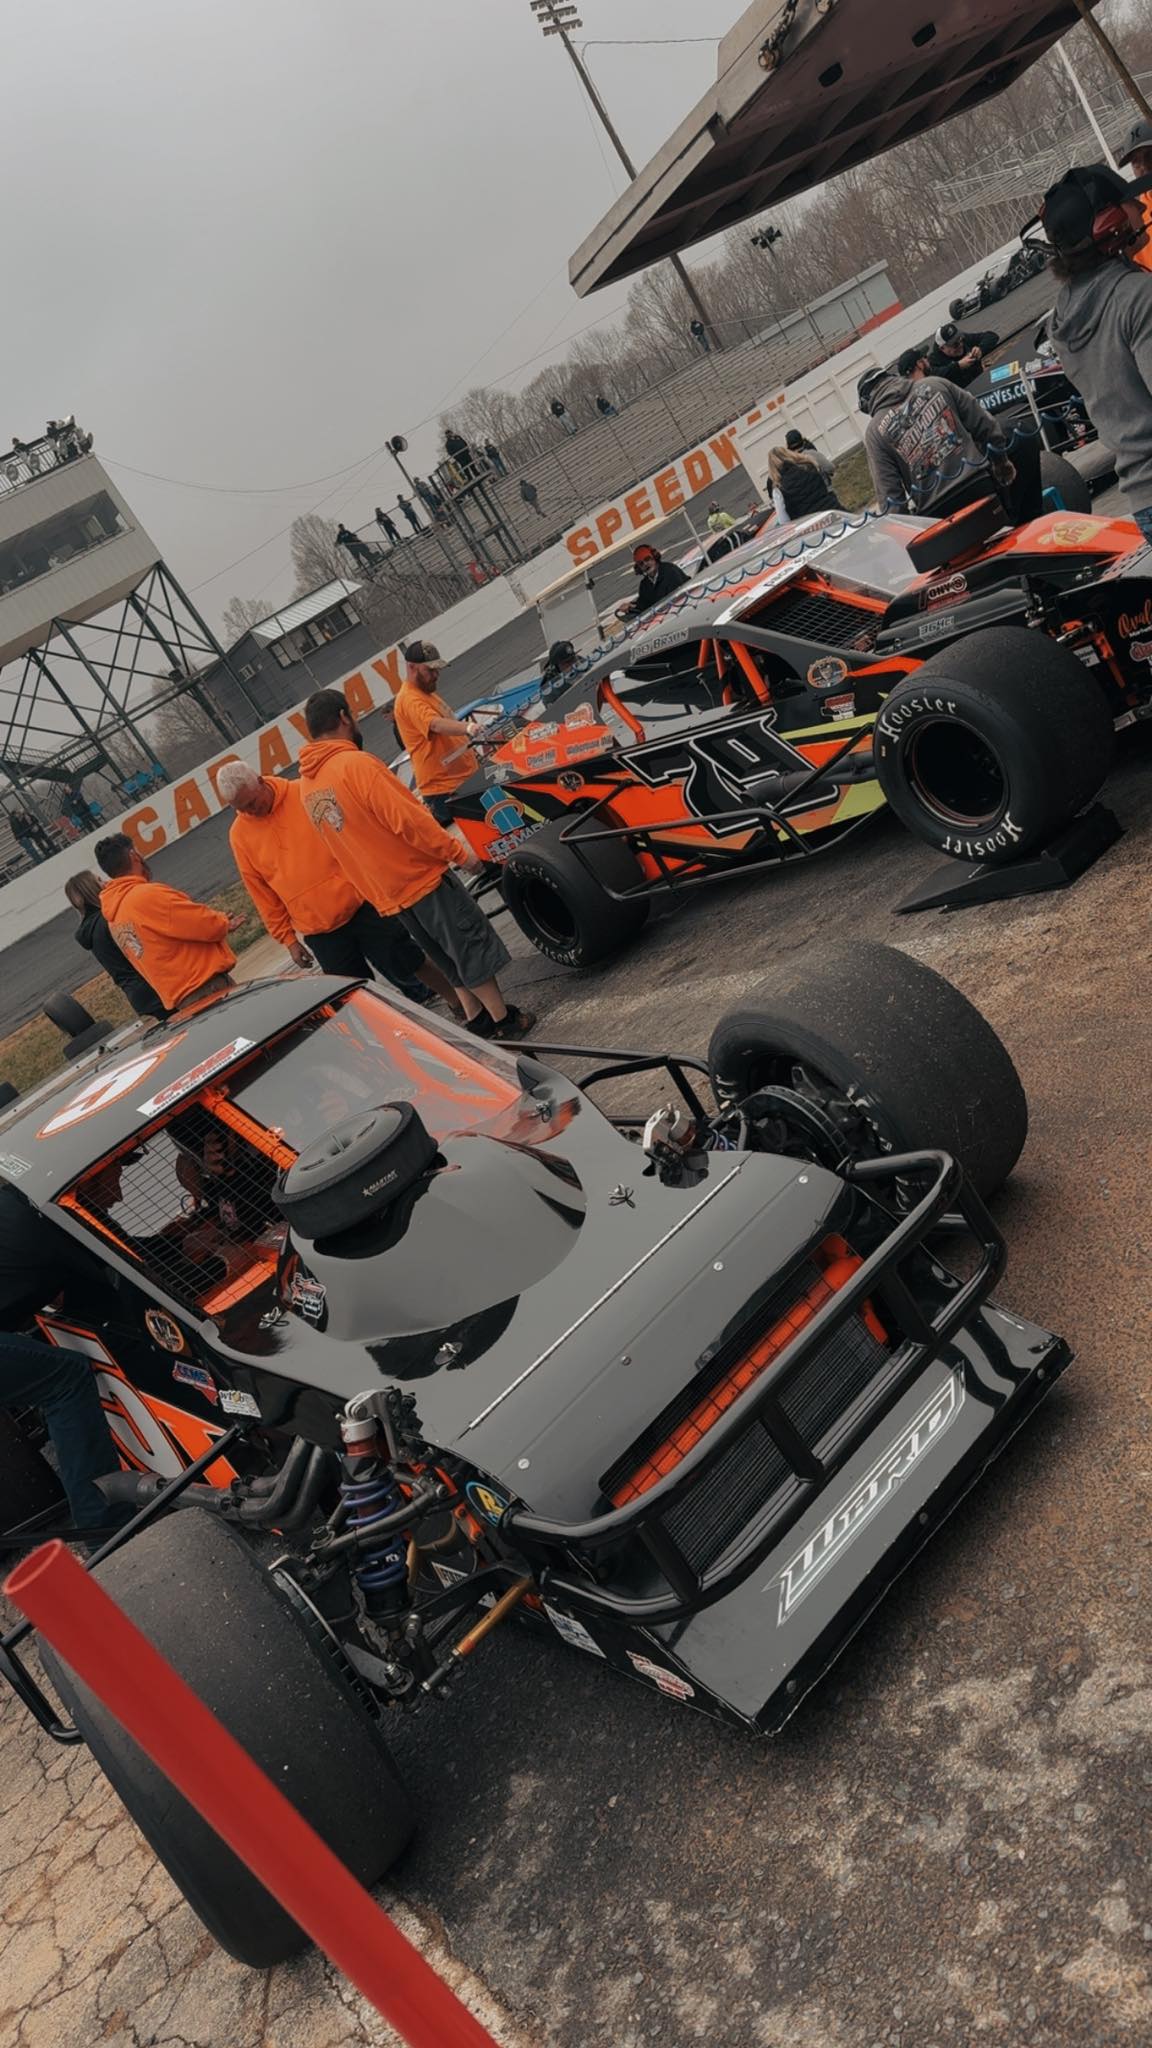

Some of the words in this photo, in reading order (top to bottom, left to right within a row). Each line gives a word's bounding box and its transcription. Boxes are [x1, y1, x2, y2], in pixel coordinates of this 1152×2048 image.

[566, 394, 785, 568] SPEEDW
[121, 649, 402, 857] CAAAY
[878, 697, 957, 744] Hoosier
[941, 811, 1024, 857] Hoosier
